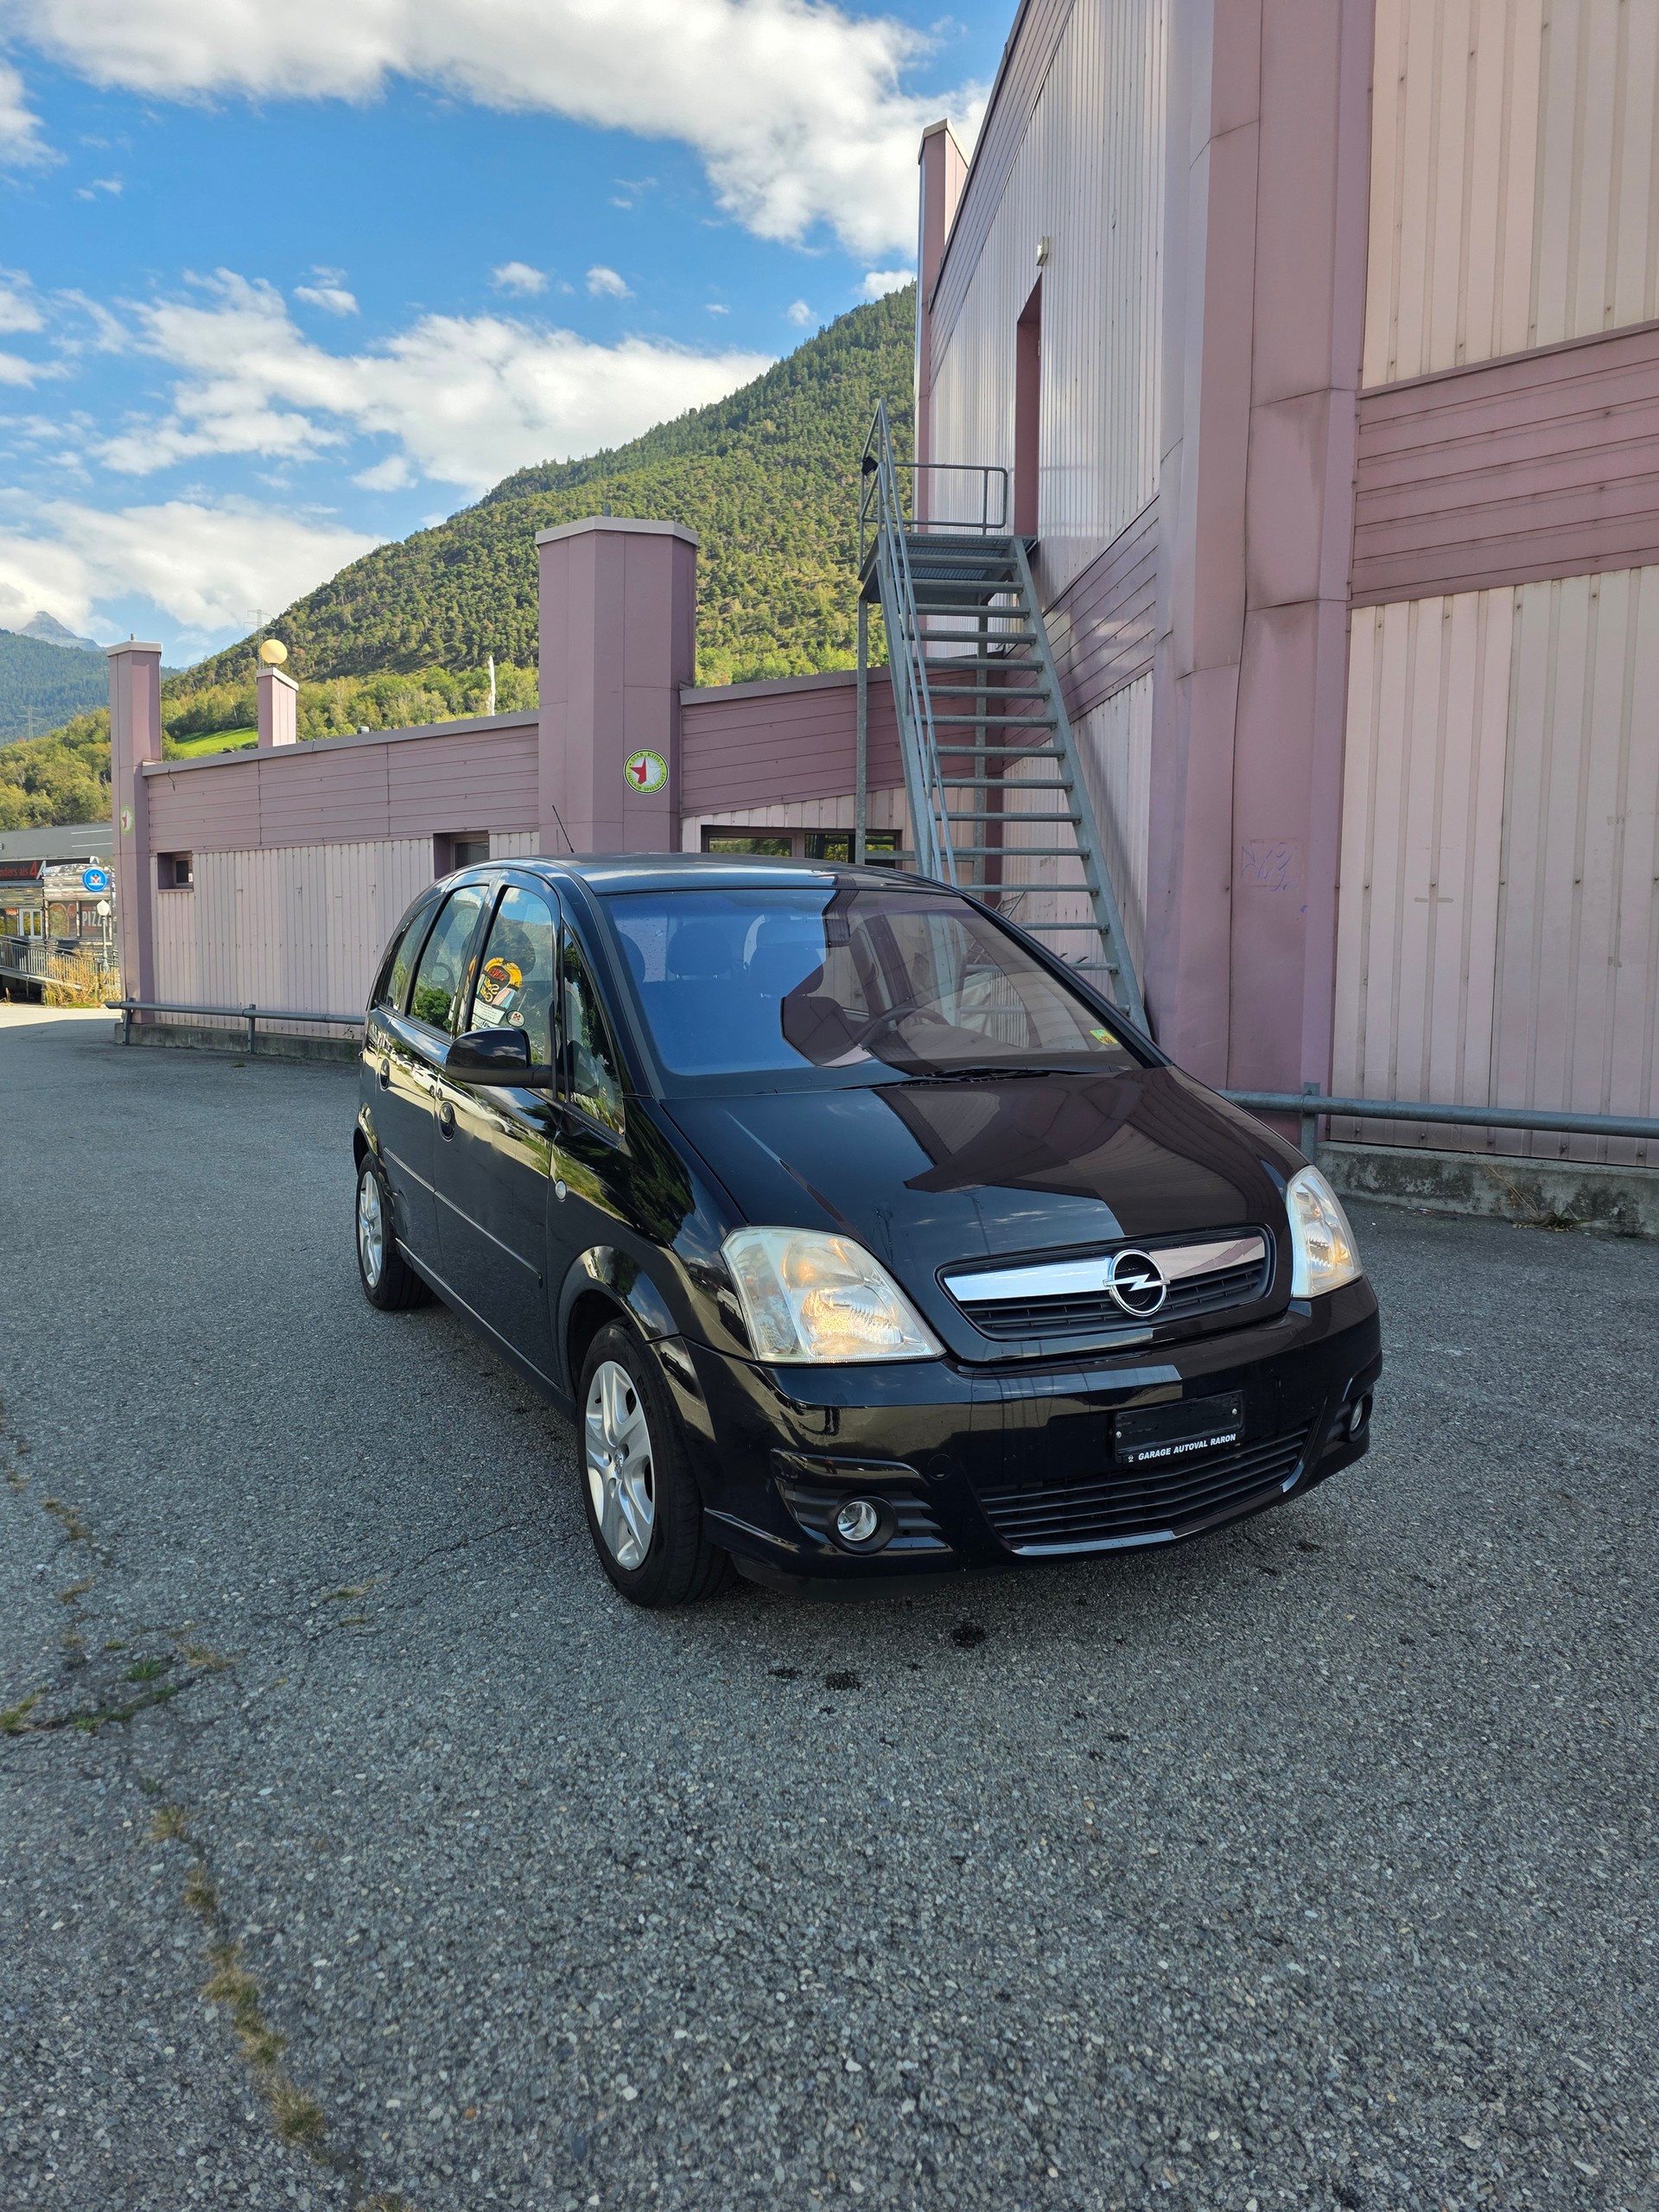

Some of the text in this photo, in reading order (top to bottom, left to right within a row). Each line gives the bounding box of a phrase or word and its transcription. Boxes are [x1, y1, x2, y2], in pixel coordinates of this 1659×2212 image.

[631, 753, 661, 763] STAR KIDS
[1138, 1433, 1236, 1461] GARAGE AUTOVAL RARON
